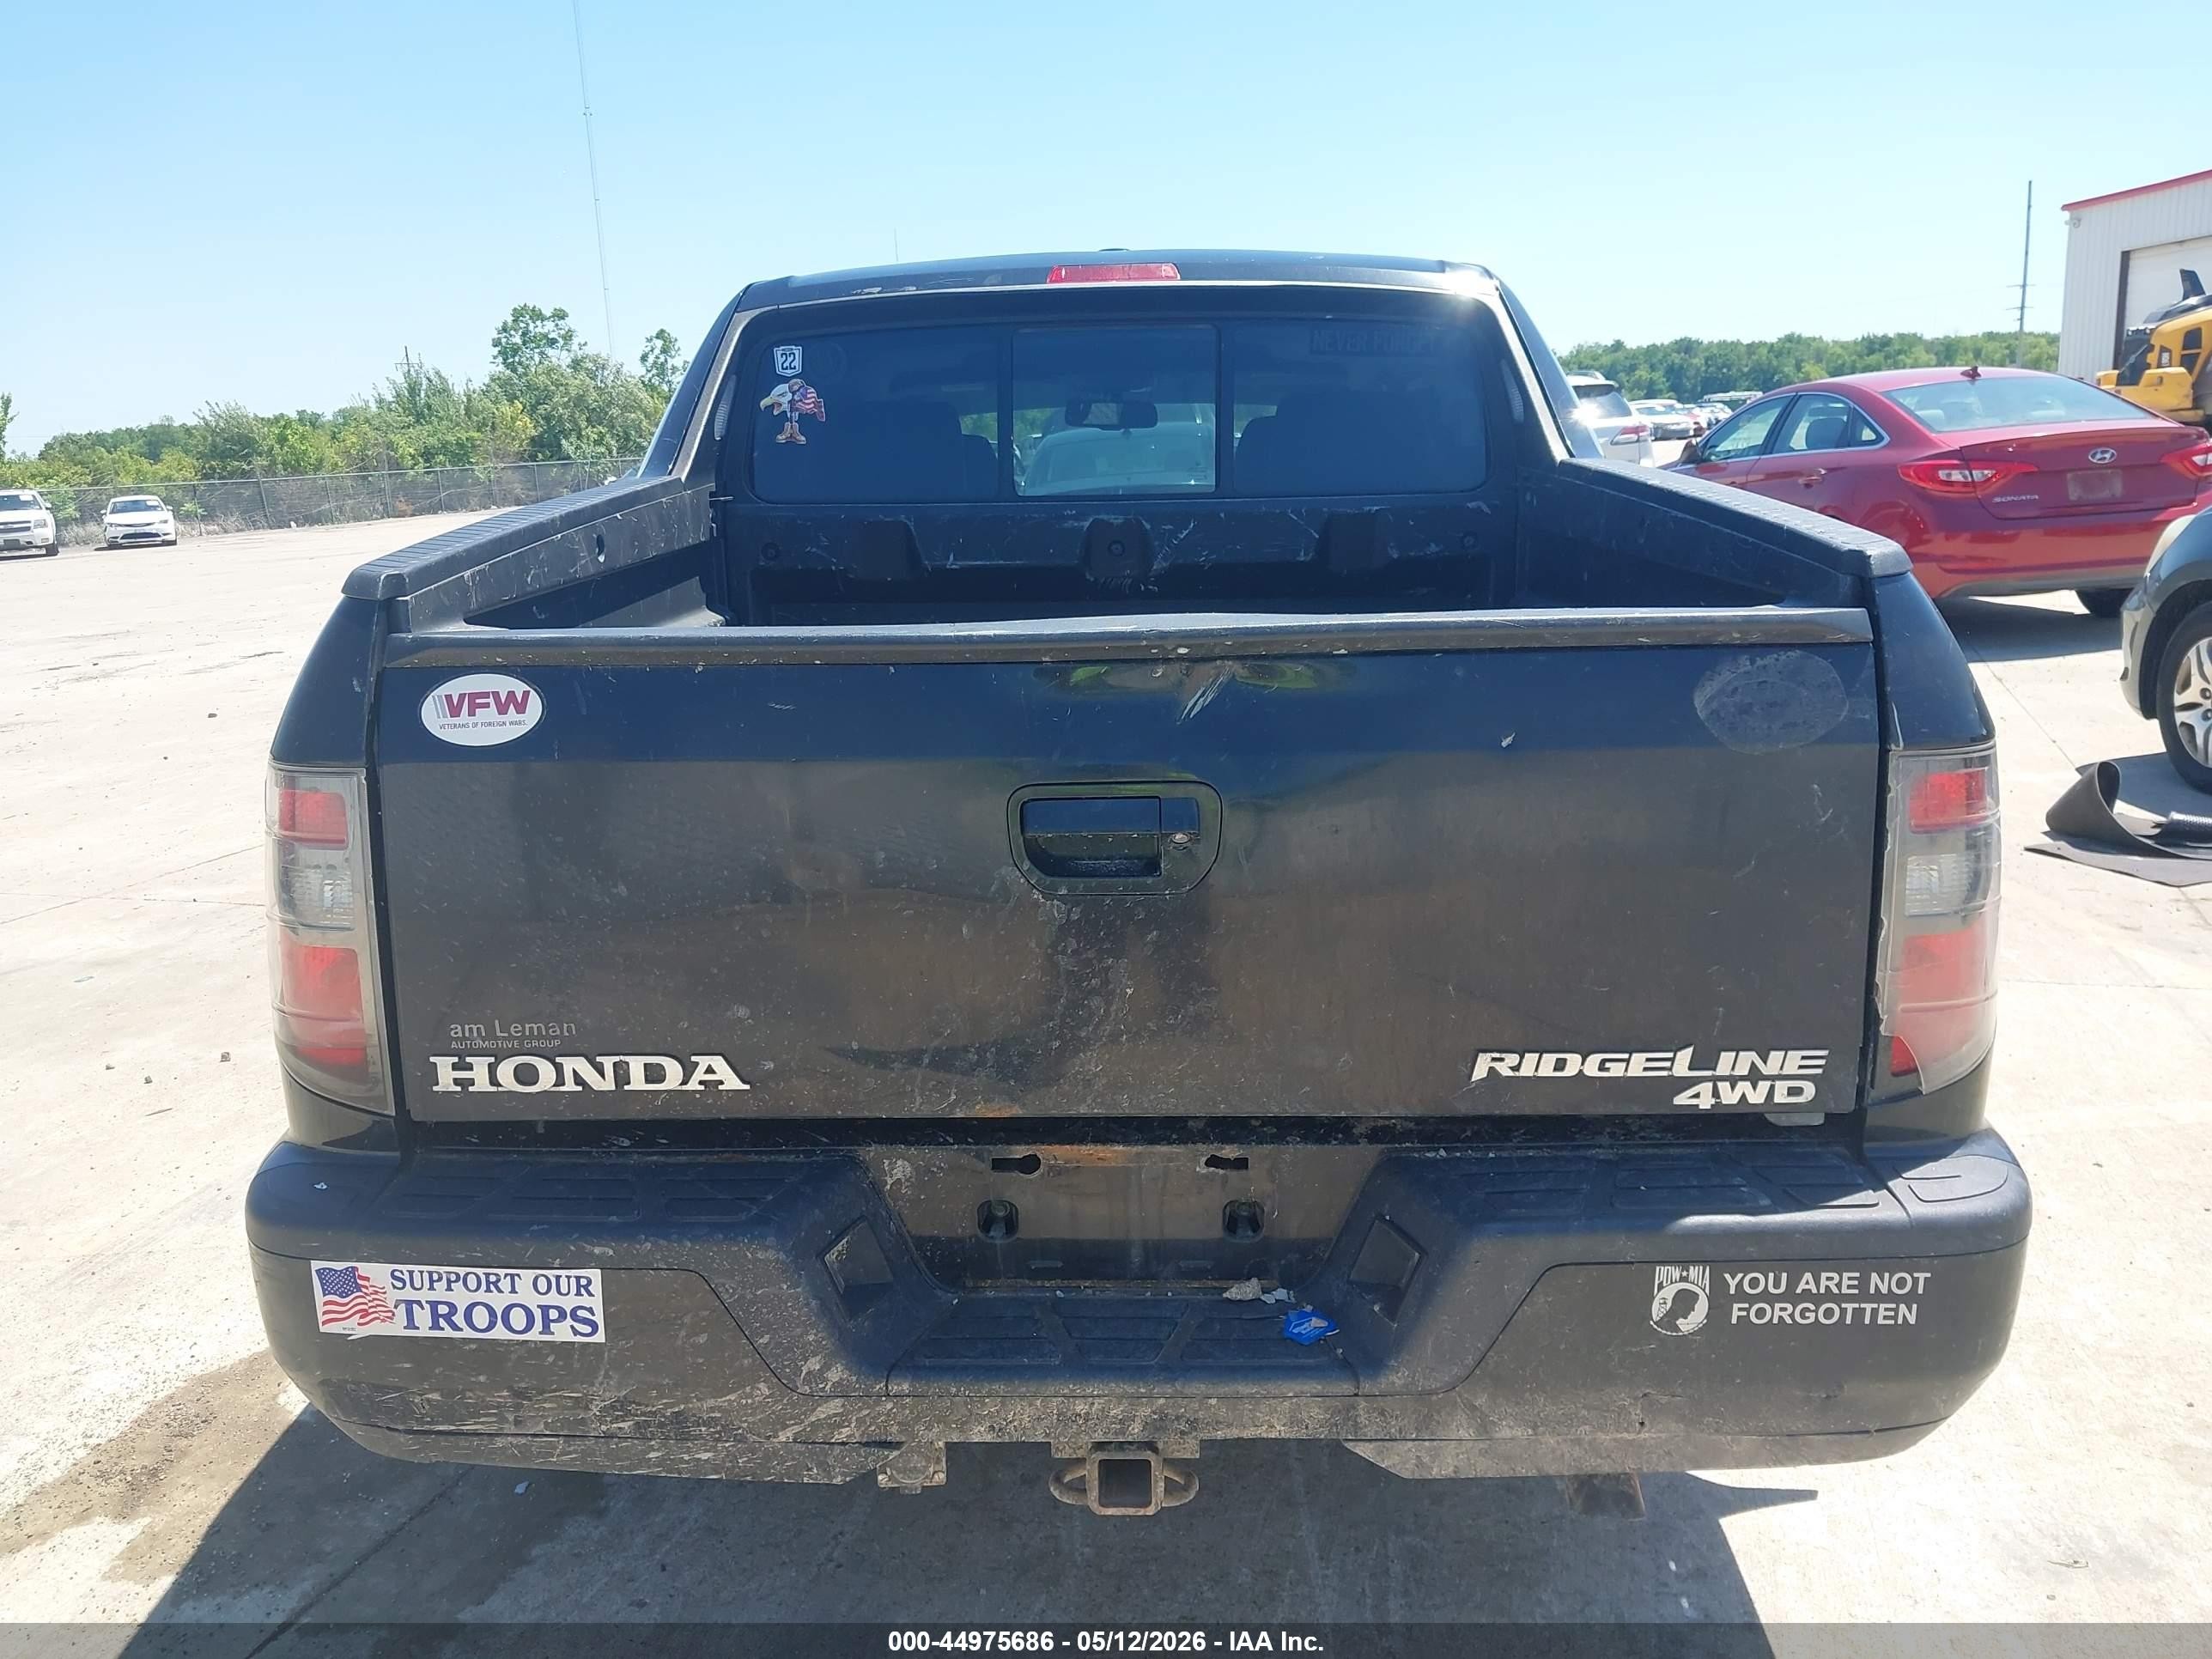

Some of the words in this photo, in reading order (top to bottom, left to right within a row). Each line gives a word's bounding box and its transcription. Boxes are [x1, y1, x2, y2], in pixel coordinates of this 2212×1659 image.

[781, 352, 796, 370] 22
[444, 690, 531, 718] VFW
[495, 1019, 577, 1037] Leman
[451, 1040, 520, 1049] AUTOMOTIVE
[524, 1039, 562, 1048] GROUP
[428, 1054, 750, 1093] HONDA
[1673, 1080, 1817, 1109] 4WD
[390, 1268, 522, 1294] SUPPORT
[532, 1273, 596, 1297] OUR
[1723, 1272, 1788, 1295] YOU
[1796, 1272, 1860, 1295] ARE
[1869, 1272, 1931, 1295] NOT
[392, 1299, 600, 1338] TROOPS
[1730, 1303, 1917, 1325] FORGOTTEN
